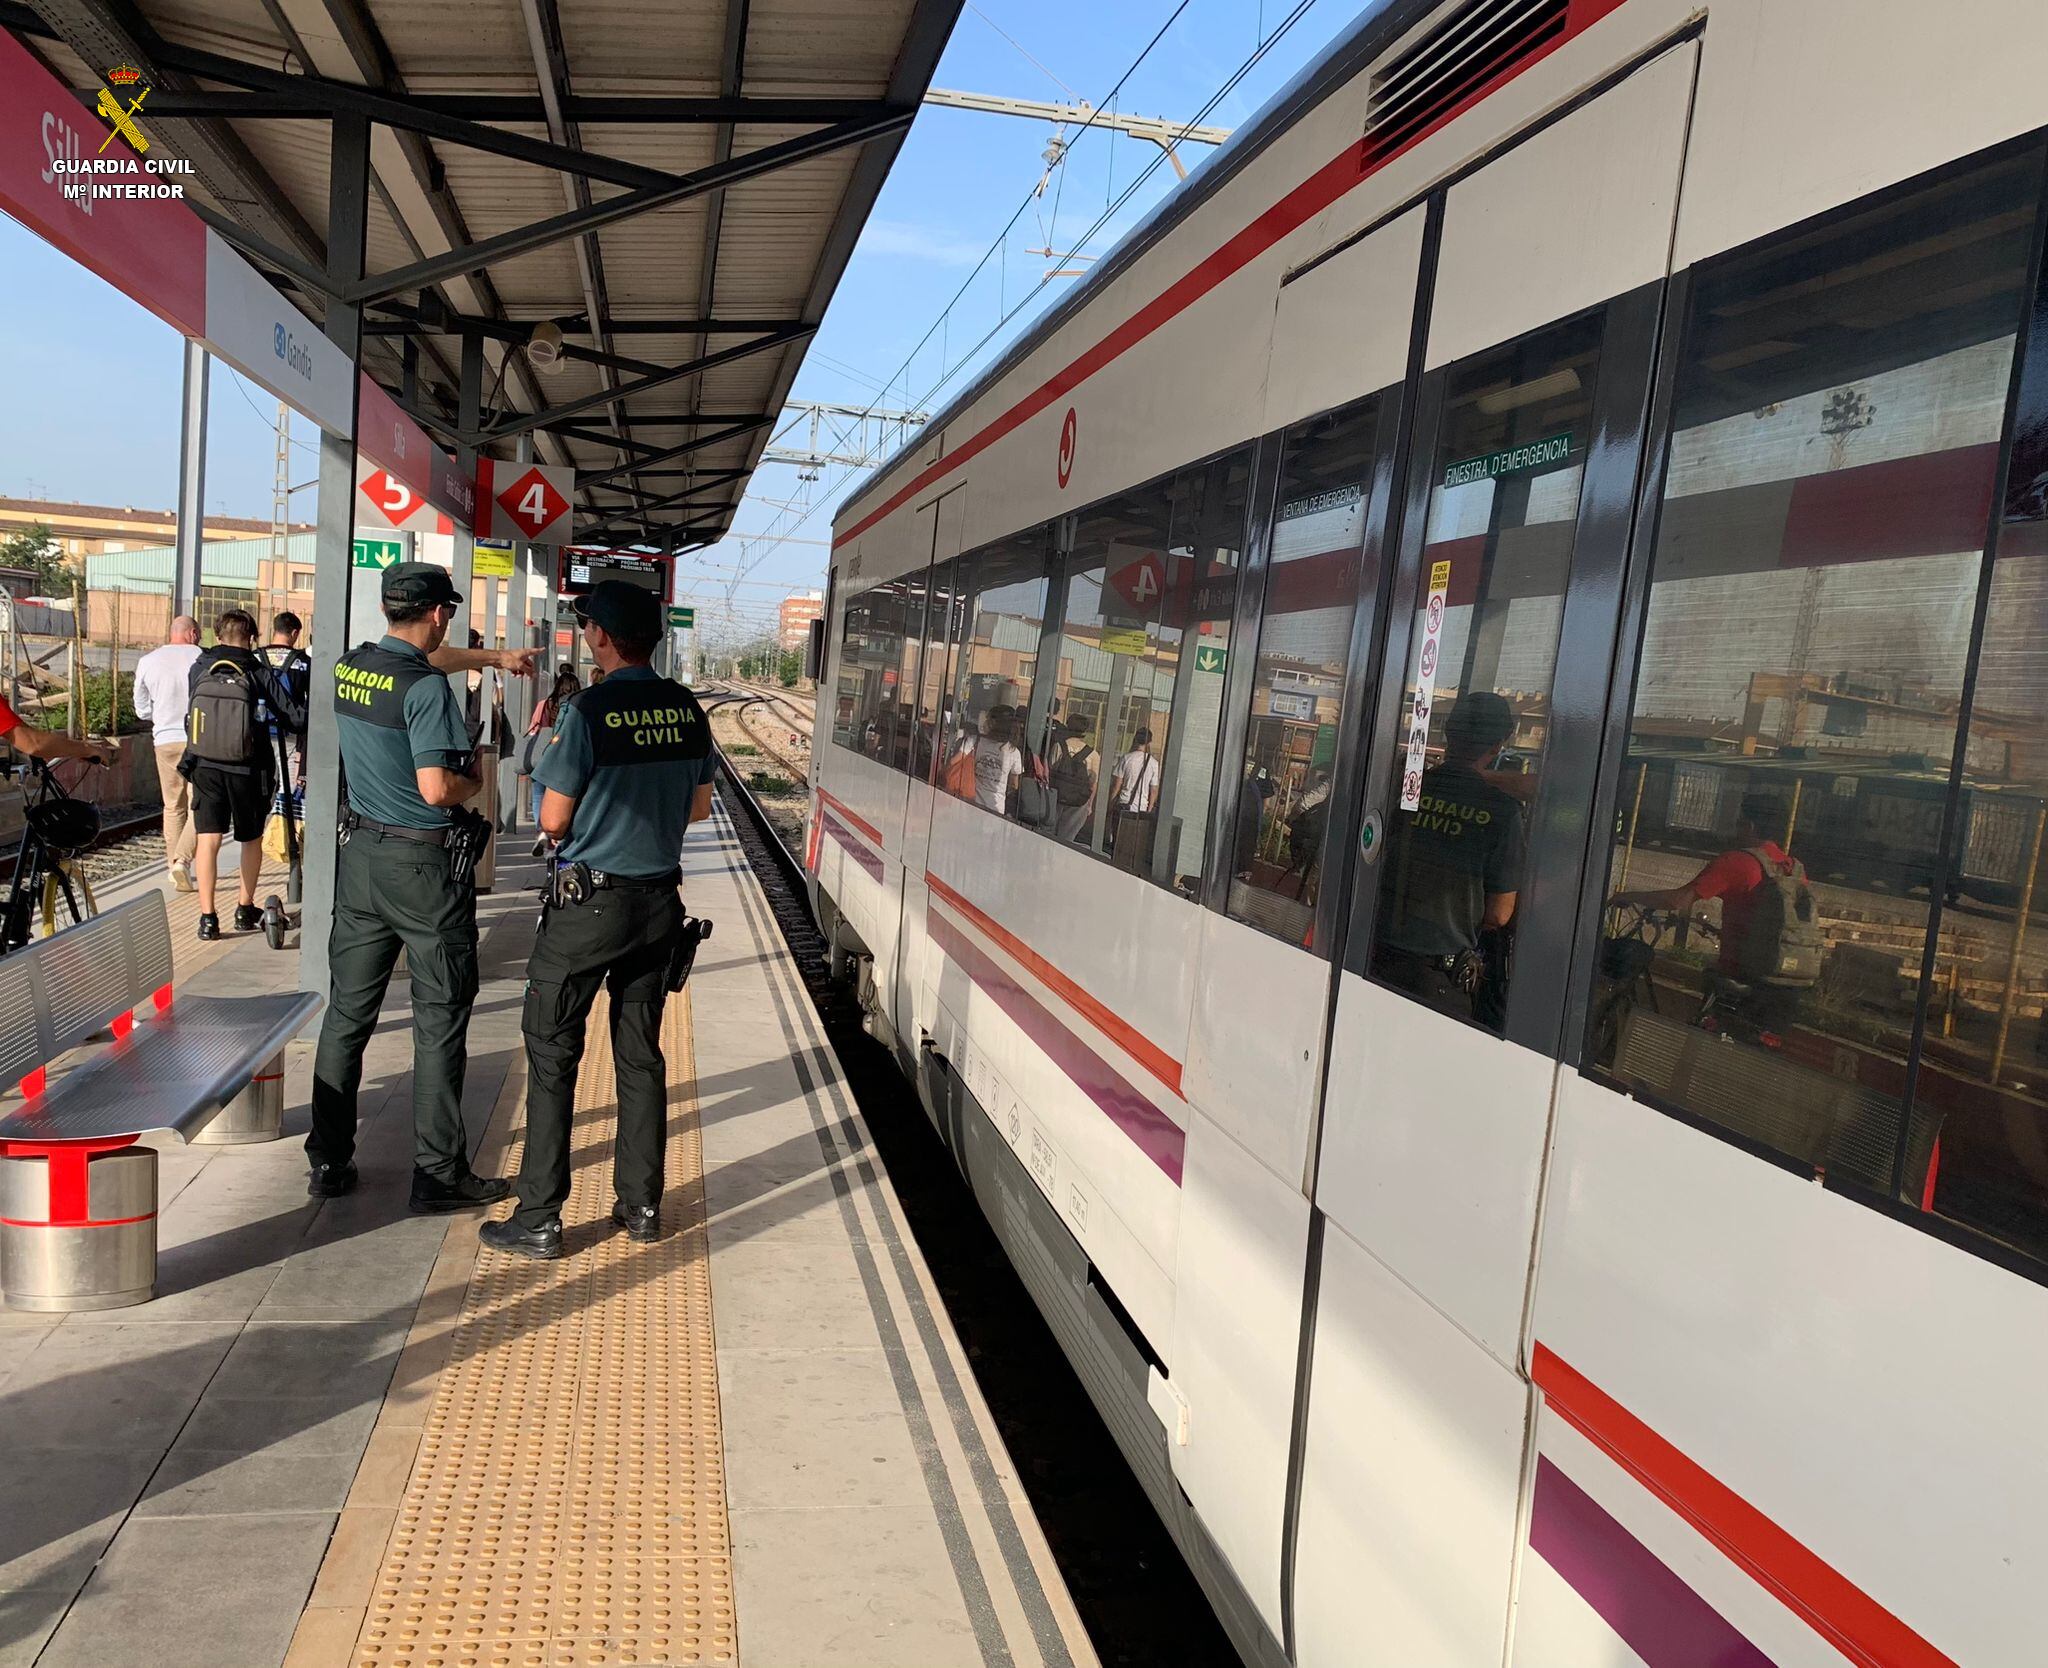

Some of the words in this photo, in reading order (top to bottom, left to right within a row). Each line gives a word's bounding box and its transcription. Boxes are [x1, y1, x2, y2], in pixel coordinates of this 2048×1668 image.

[1445, 459, 1488, 486] FINESTRA
[383, 473, 411, 511] 5
[518, 483, 548, 525] 4
[1319, 485, 1360, 508] EMERGENCIA
[335, 663, 394, 692] GUARDIA
[338, 683, 371, 706] CIVIL
[605, 707, 696, 728] GUARDIA
[633, 727, 683, 746] CIVIL
